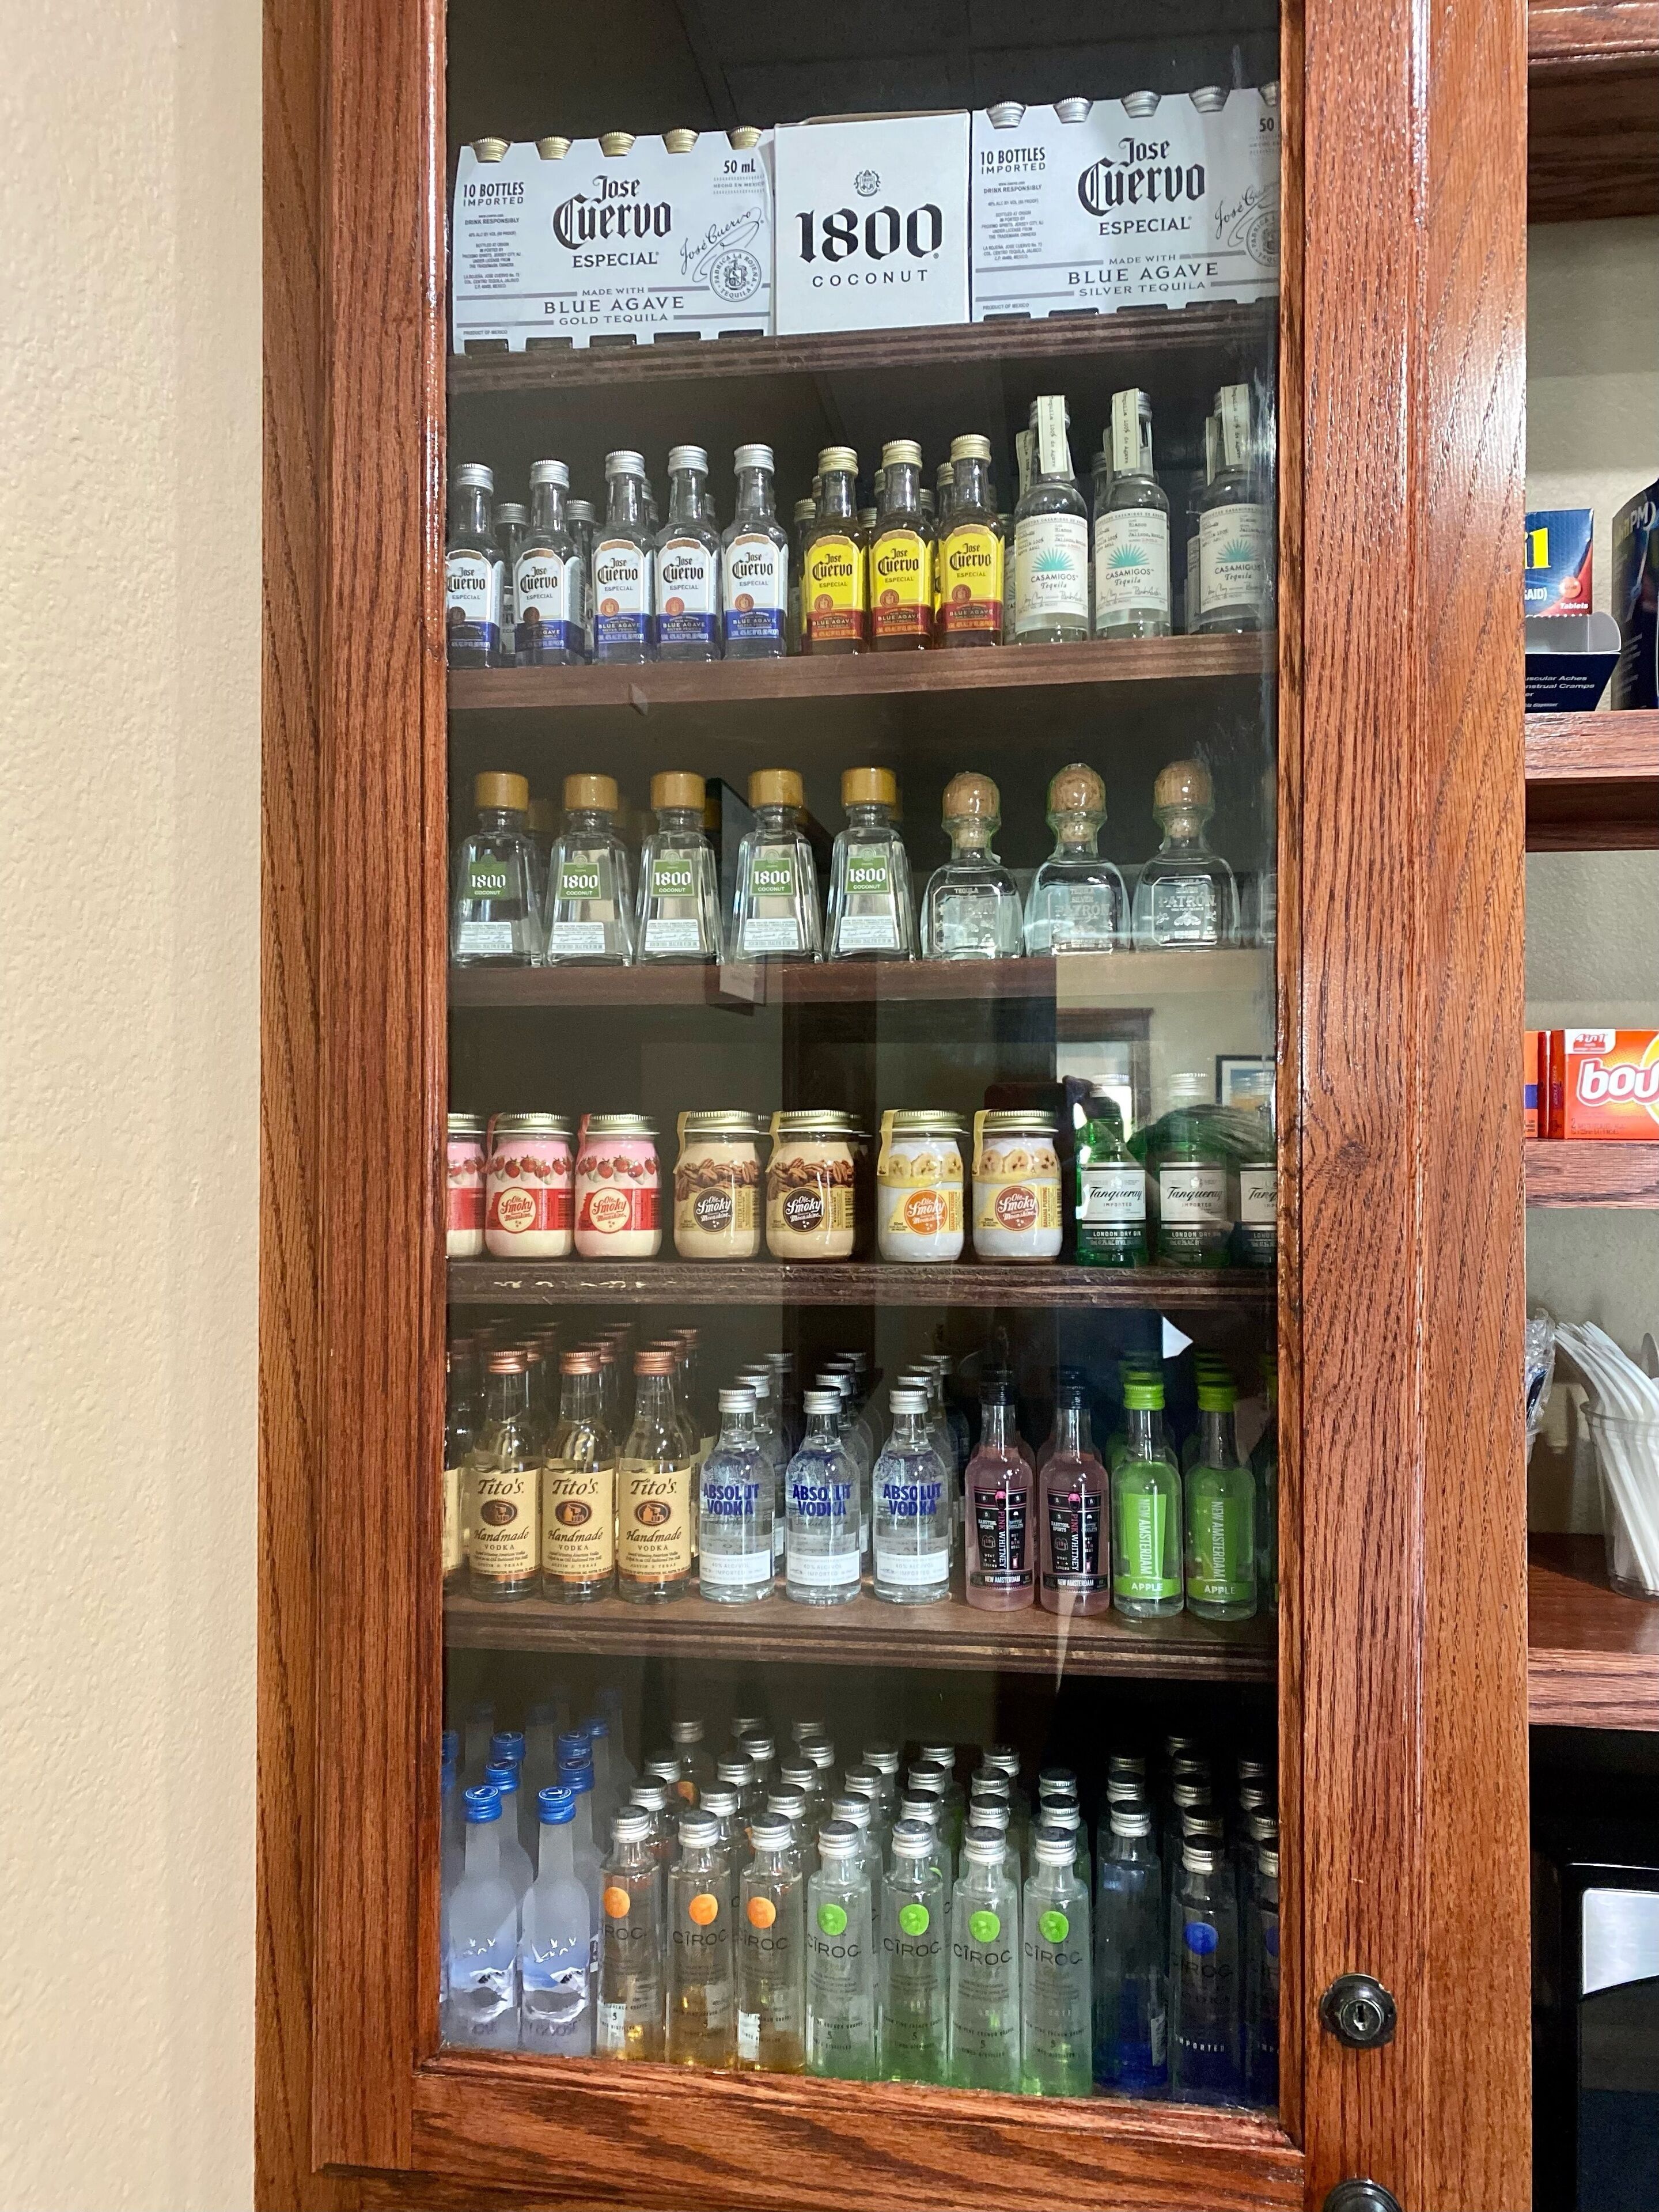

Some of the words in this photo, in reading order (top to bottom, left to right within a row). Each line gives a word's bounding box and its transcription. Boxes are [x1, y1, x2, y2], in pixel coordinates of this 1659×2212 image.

[1259, 117, 1275, 132] 50
[980, 151, 994, 165] 10
[998, 146, 1045, 164] BOTTLES
[1118, 137, 1170, 166] Jose
[724, 160, 737, 174] 50
[741, 158, 756, 173] mL
[982, 162, 1046, 175] IMPORTED
[464, 184, 476, 198] 10
[479, 181, 524, 197] BOTTLES
[592, 175, 640, 204] Jose
[1003, 184, 1042, 192] RESPONSIBLY
[1078, 156, 1205, 217] Cuervo
[463, 196, 524, 207] IMPORTED
[553, 194, 672, 250] Cuervo
[1099, 217, 1191, 236] ESPECIAL
[795, 203, 943, 263] 1800
[572, 252, 659, 268] ESPECIAL
[1109, 256, 1142, 265] MADE
[1145, 254, 1176, 263] WITH
[812, 269, 927, 287] COCONUT
[1068, 268, 1129, 285] BLUE
[1139, 262, 1218, 280] AGAVE
[582, 289, 613, 297] MADE
[616, 287, 645, 295] WITH
[720, 288, 752, 299] TEQUILA
[1080, 286, 1132, 297] SILVER
[1138, 281, 1206, 294] TEQUILA
[544, 300, 601, 315] BLUE
[611, 296, 684, 312] AGAVE
[559, 316, 599, 325] GOLD
[604, 313, 669, 324] TEQUILA
[891, 548, 908, 559] Jose
[964, 543, 980, 555] Jose
[611, 558, 627, 569] Jose
[676, 556, 693, 567] Jose
[745, 552, 762, 563] Jose
[825, 554, 842, 565] Jose
[877, 556, 919, 575] Cuervo
[950, 551, 991, 571] Cuervo
[460, 567, 475, 577] Jose
[531, 566, 547, 577] Jose
[597, 565, 638, 584] Cuervo
[662, 563, 703, 584] Cuervo
[732, 559, 773, 579] Cuervo
[812, 561, 853, 581] Cuervo
[1105, 569, 1151, 580] CASAMIGOS
[520, 575, 558, 593] Cuervo
[1031, 573, 1076, 583] CASAMIGOS
[1040, 581, 1067, 590] Tequila
[1115, 577, 1141, 587] Tequila
[471, 874, 506, 888] 1800
[562, 874, 598, 889] 1800
[654, 871, 691, 886] 1800
[754, 870, 790, 885] 1800
[849, 868, 886, 883] 1800
[1089, 1186, 1143, 1201] Tanqueray
[1167, 1186, 1223, 1201] Tanqueray
[500, 1198, 532, 1214] Smoky
[592, 1198, 626, 1215] Smoky
[696, 1198, 732, 1214] Smoky
[786, 1198, 821, 1214] Smoky
[921, 1198, 934, 1206] Ole
[998, 1195, 1036, 1213] Smoky
[478, 1478, 524, 1495] Tito's
[552, 1478, 598, 1495] Tito's
[630, 1478, 677, 1495] Tito's
[703, 1483, 759, 1501] ABSOLUT
[883, 1483, 941, 1501] ABSOLUT
[707, 1499, 753, 1516] VODKA
[798, 1501, 846, 1517] VODKA
[889, 1499, 937, 1516] VODKA
[1138, 1499, 1150, 1518] NEW
[1211, 1501, 1224, 1521] NEW
[474, 1527, 529, 1541] Handmade
[548, 1527, 603, 1542] Handmade
[626, 1527, 682, 1542] Handmade
[998, 1531, 1006, 1568] WHITNEY
[1071, 1533, 1079, 1571] WHITNEY
[1138, 1519, 1153, 1574] AMSTERDAM
[1212, 1521, 1226, 1578] AMSTERDAM
[994, 1575, 1021, 1583] AMSTERDAM
[1131, 1582, 1163, 1591] APPLE
[1204, 1585, 1236, 1594] APPLE
